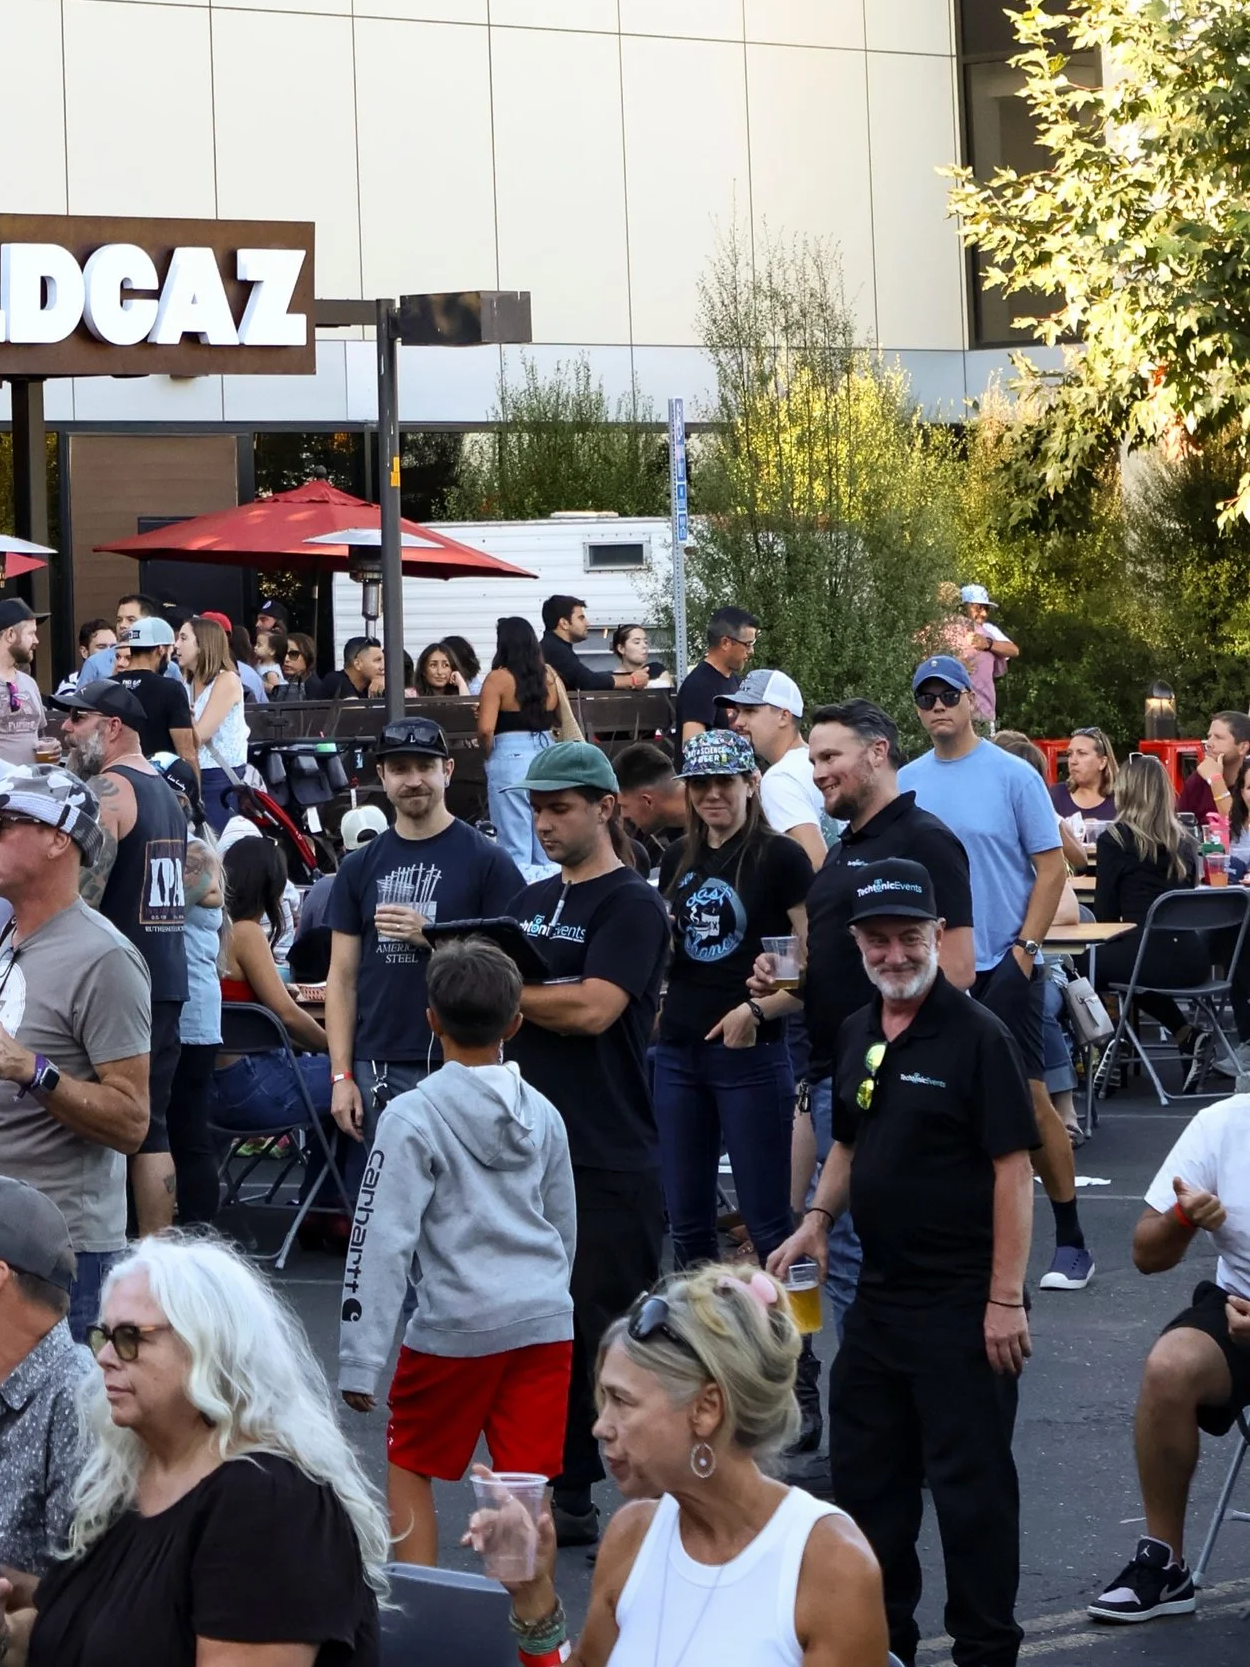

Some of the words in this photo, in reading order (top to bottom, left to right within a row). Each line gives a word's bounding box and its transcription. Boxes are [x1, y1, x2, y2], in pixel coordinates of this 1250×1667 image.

[148, 857, 185, 907] IPA
[385, 953, 419, 964] STEEL
[344, 1149, 385, 1294] carhartt
